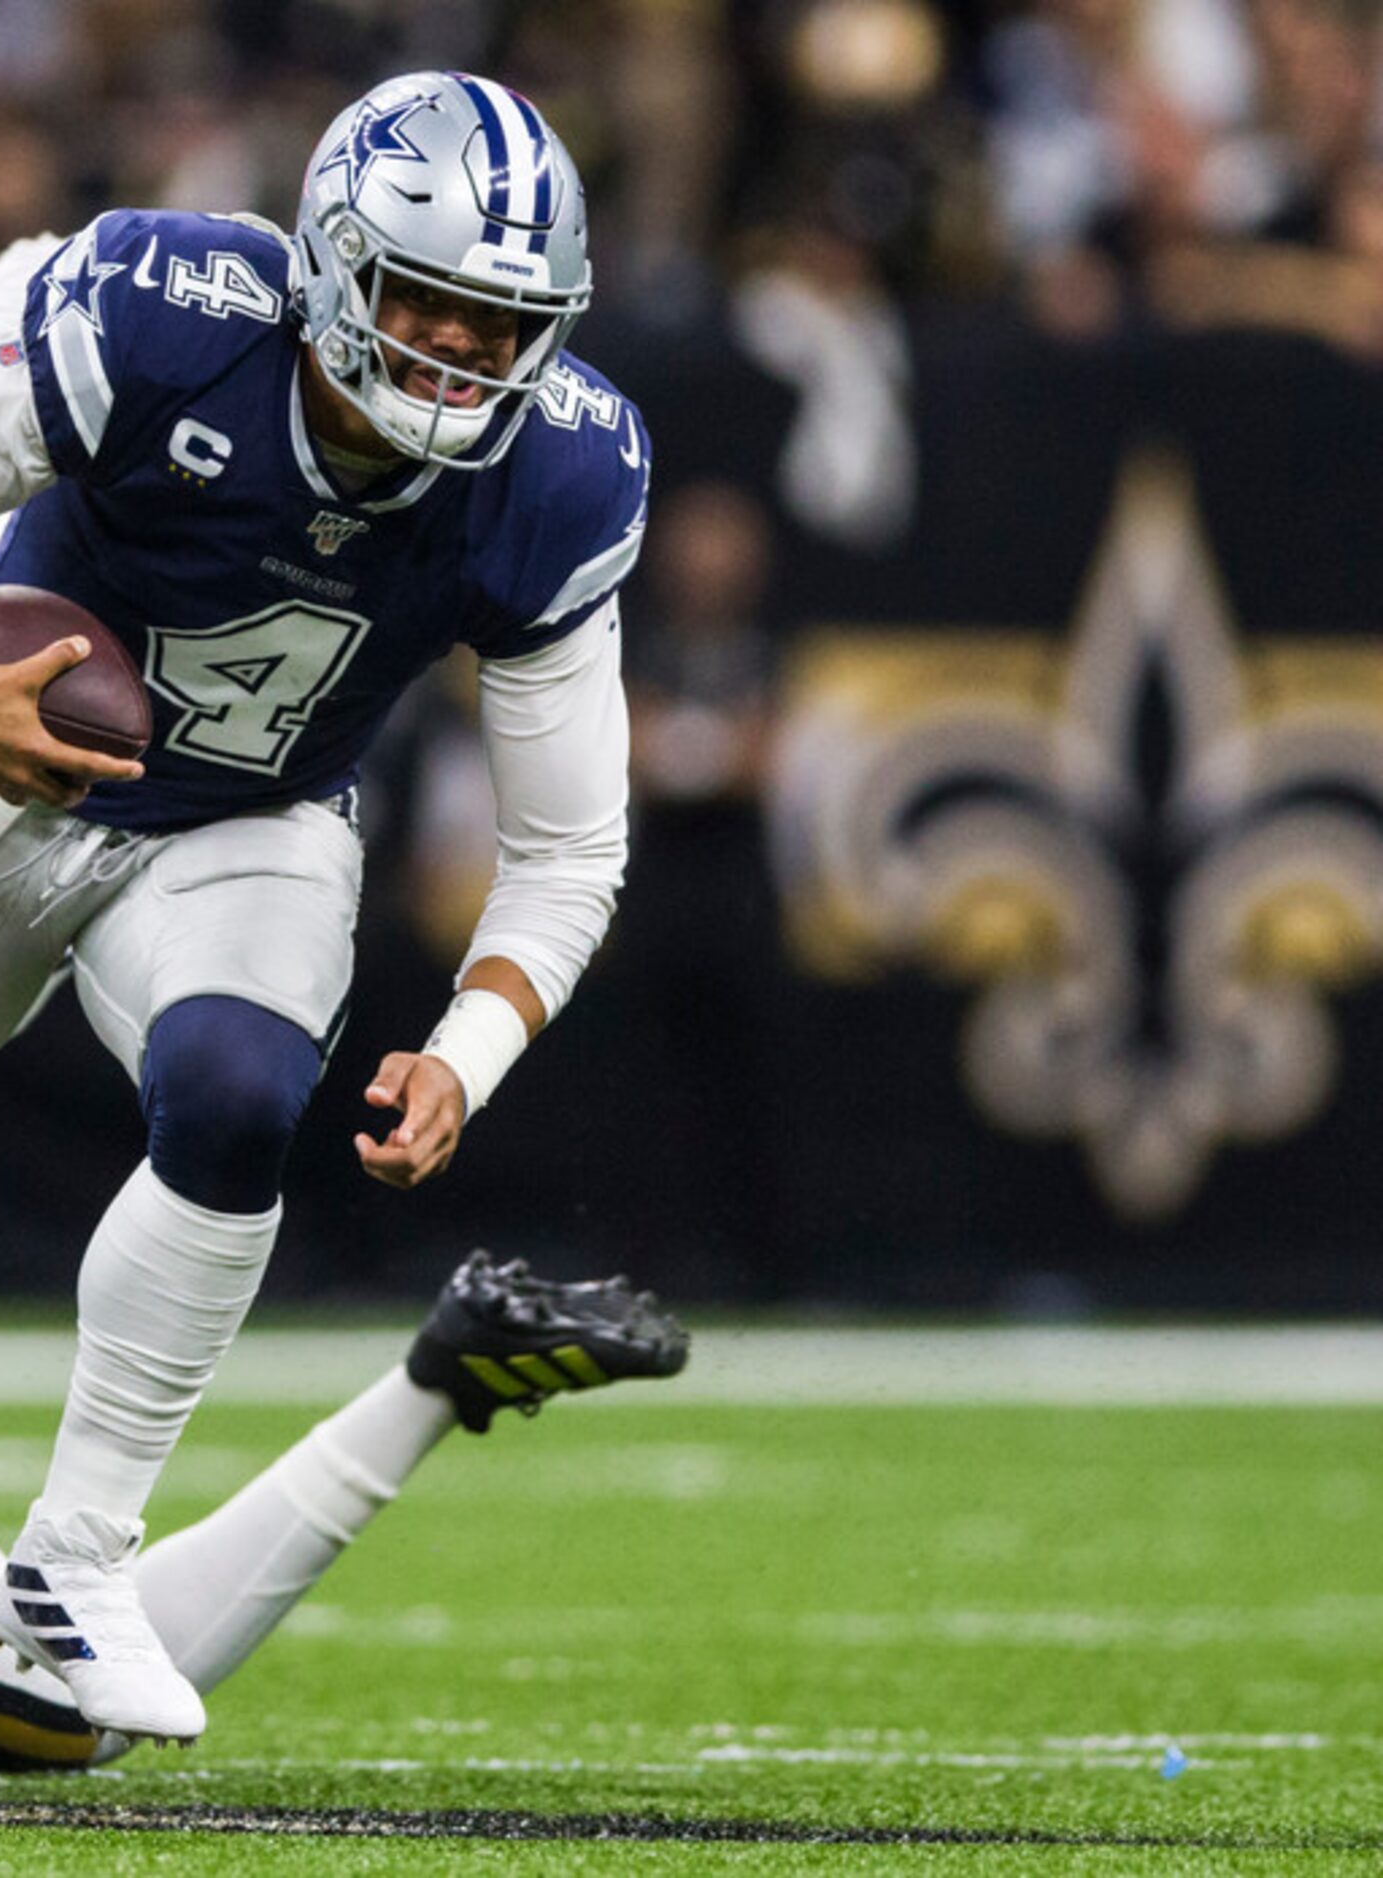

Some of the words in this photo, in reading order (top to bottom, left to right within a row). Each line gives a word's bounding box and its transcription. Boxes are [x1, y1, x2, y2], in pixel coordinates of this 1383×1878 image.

[164, 250, 283, 324] 4
[534, 364, 622, 431] 4
[168, 417, 233, 479] C
[144, 598, 373, 778] 4
